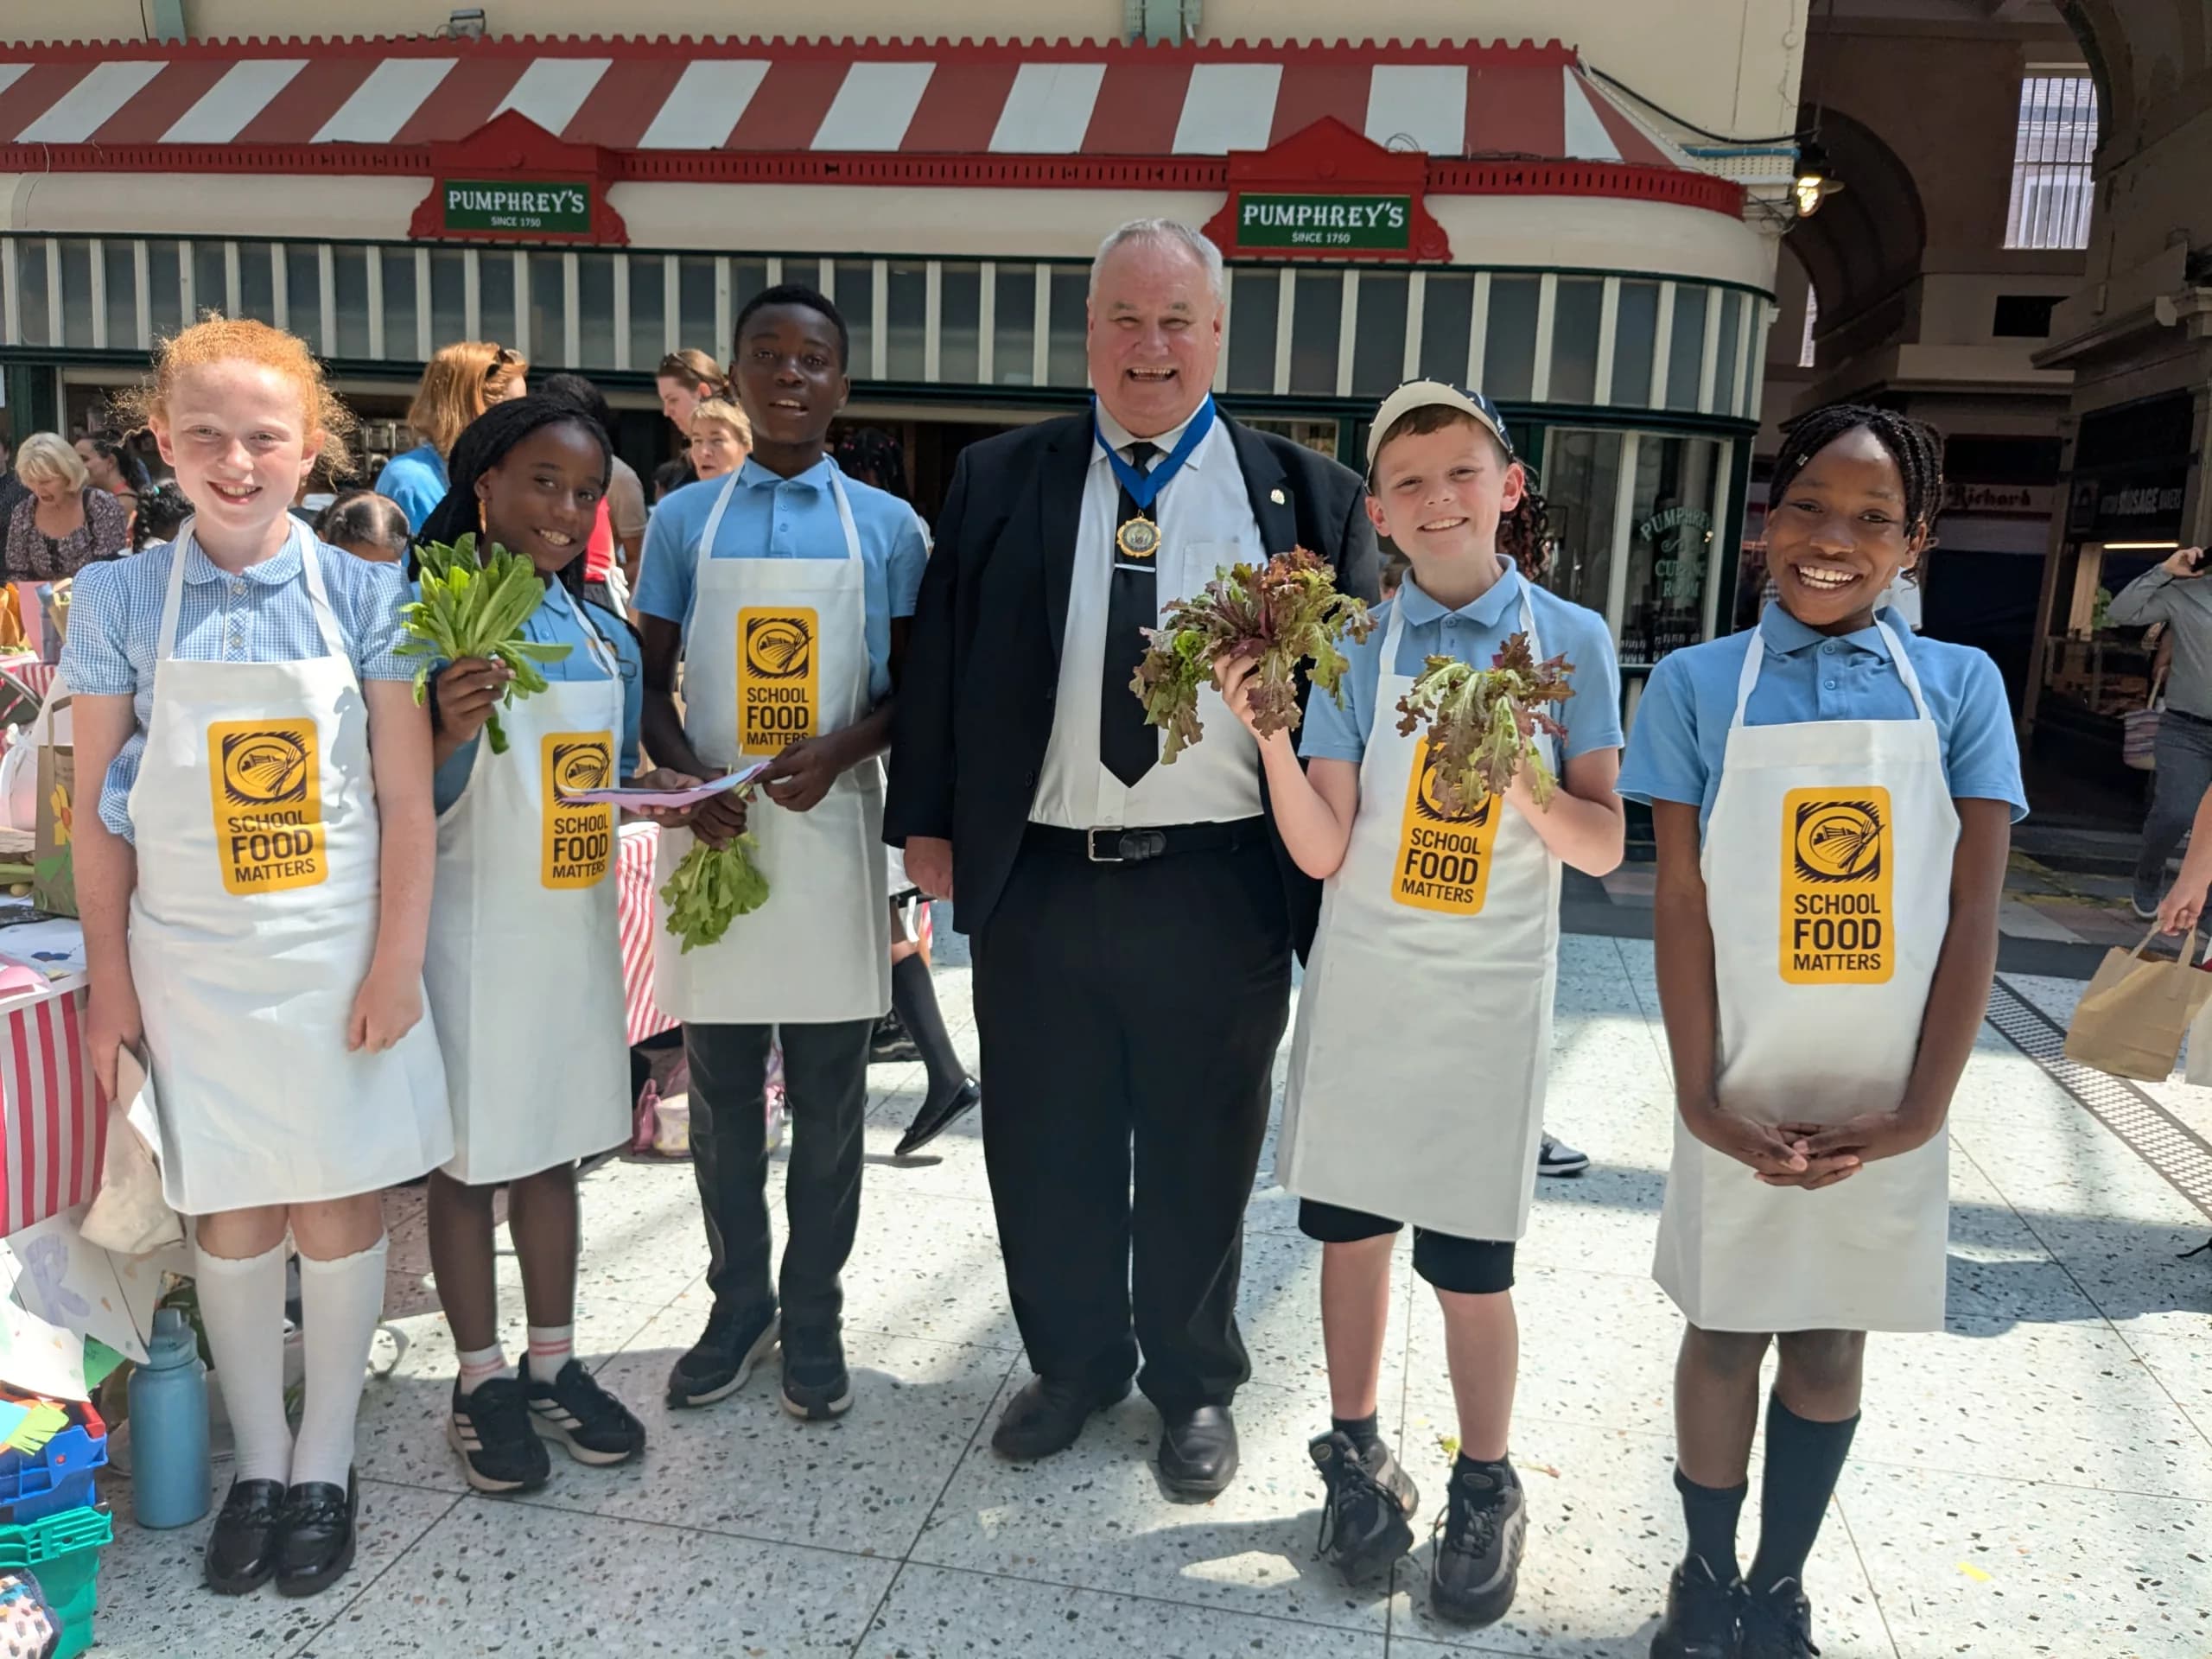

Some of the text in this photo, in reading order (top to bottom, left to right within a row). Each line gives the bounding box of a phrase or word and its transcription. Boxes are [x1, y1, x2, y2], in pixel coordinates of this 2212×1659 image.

[448, 189, 585, 214] PUMPHREY'S
[491, 216, 541, 228] SINCE 1750
[1243, 200, 1404, 228] PUMPHREY'S
[1292, 232, 1351, 244] SINCE 1750
[747, 688, 809, 703] SCHOOL
[747, 706, 809, 729] FOOD
[228, 810, 309, 833] SCHOOL
[554, 814, 608, 835] SCHOOL
[232, 829, 314, 864] FOOD
[553, 834, 608, 862] FOOD
[1410, 828, 1481, 855] SCHOOL
[235, 858, 315, 882] MATTERS
[552, 860, 605, 878] MATTERS
[1404, 848, 1478, 885] FOOD
[1401, 878, 1474, 904] MATTERS
[1794, 893, 1881, 914] SCHOOL
[1794, 918, 1881, 950] FOOD
[1794, 953, 1881, 970] MATTERS
